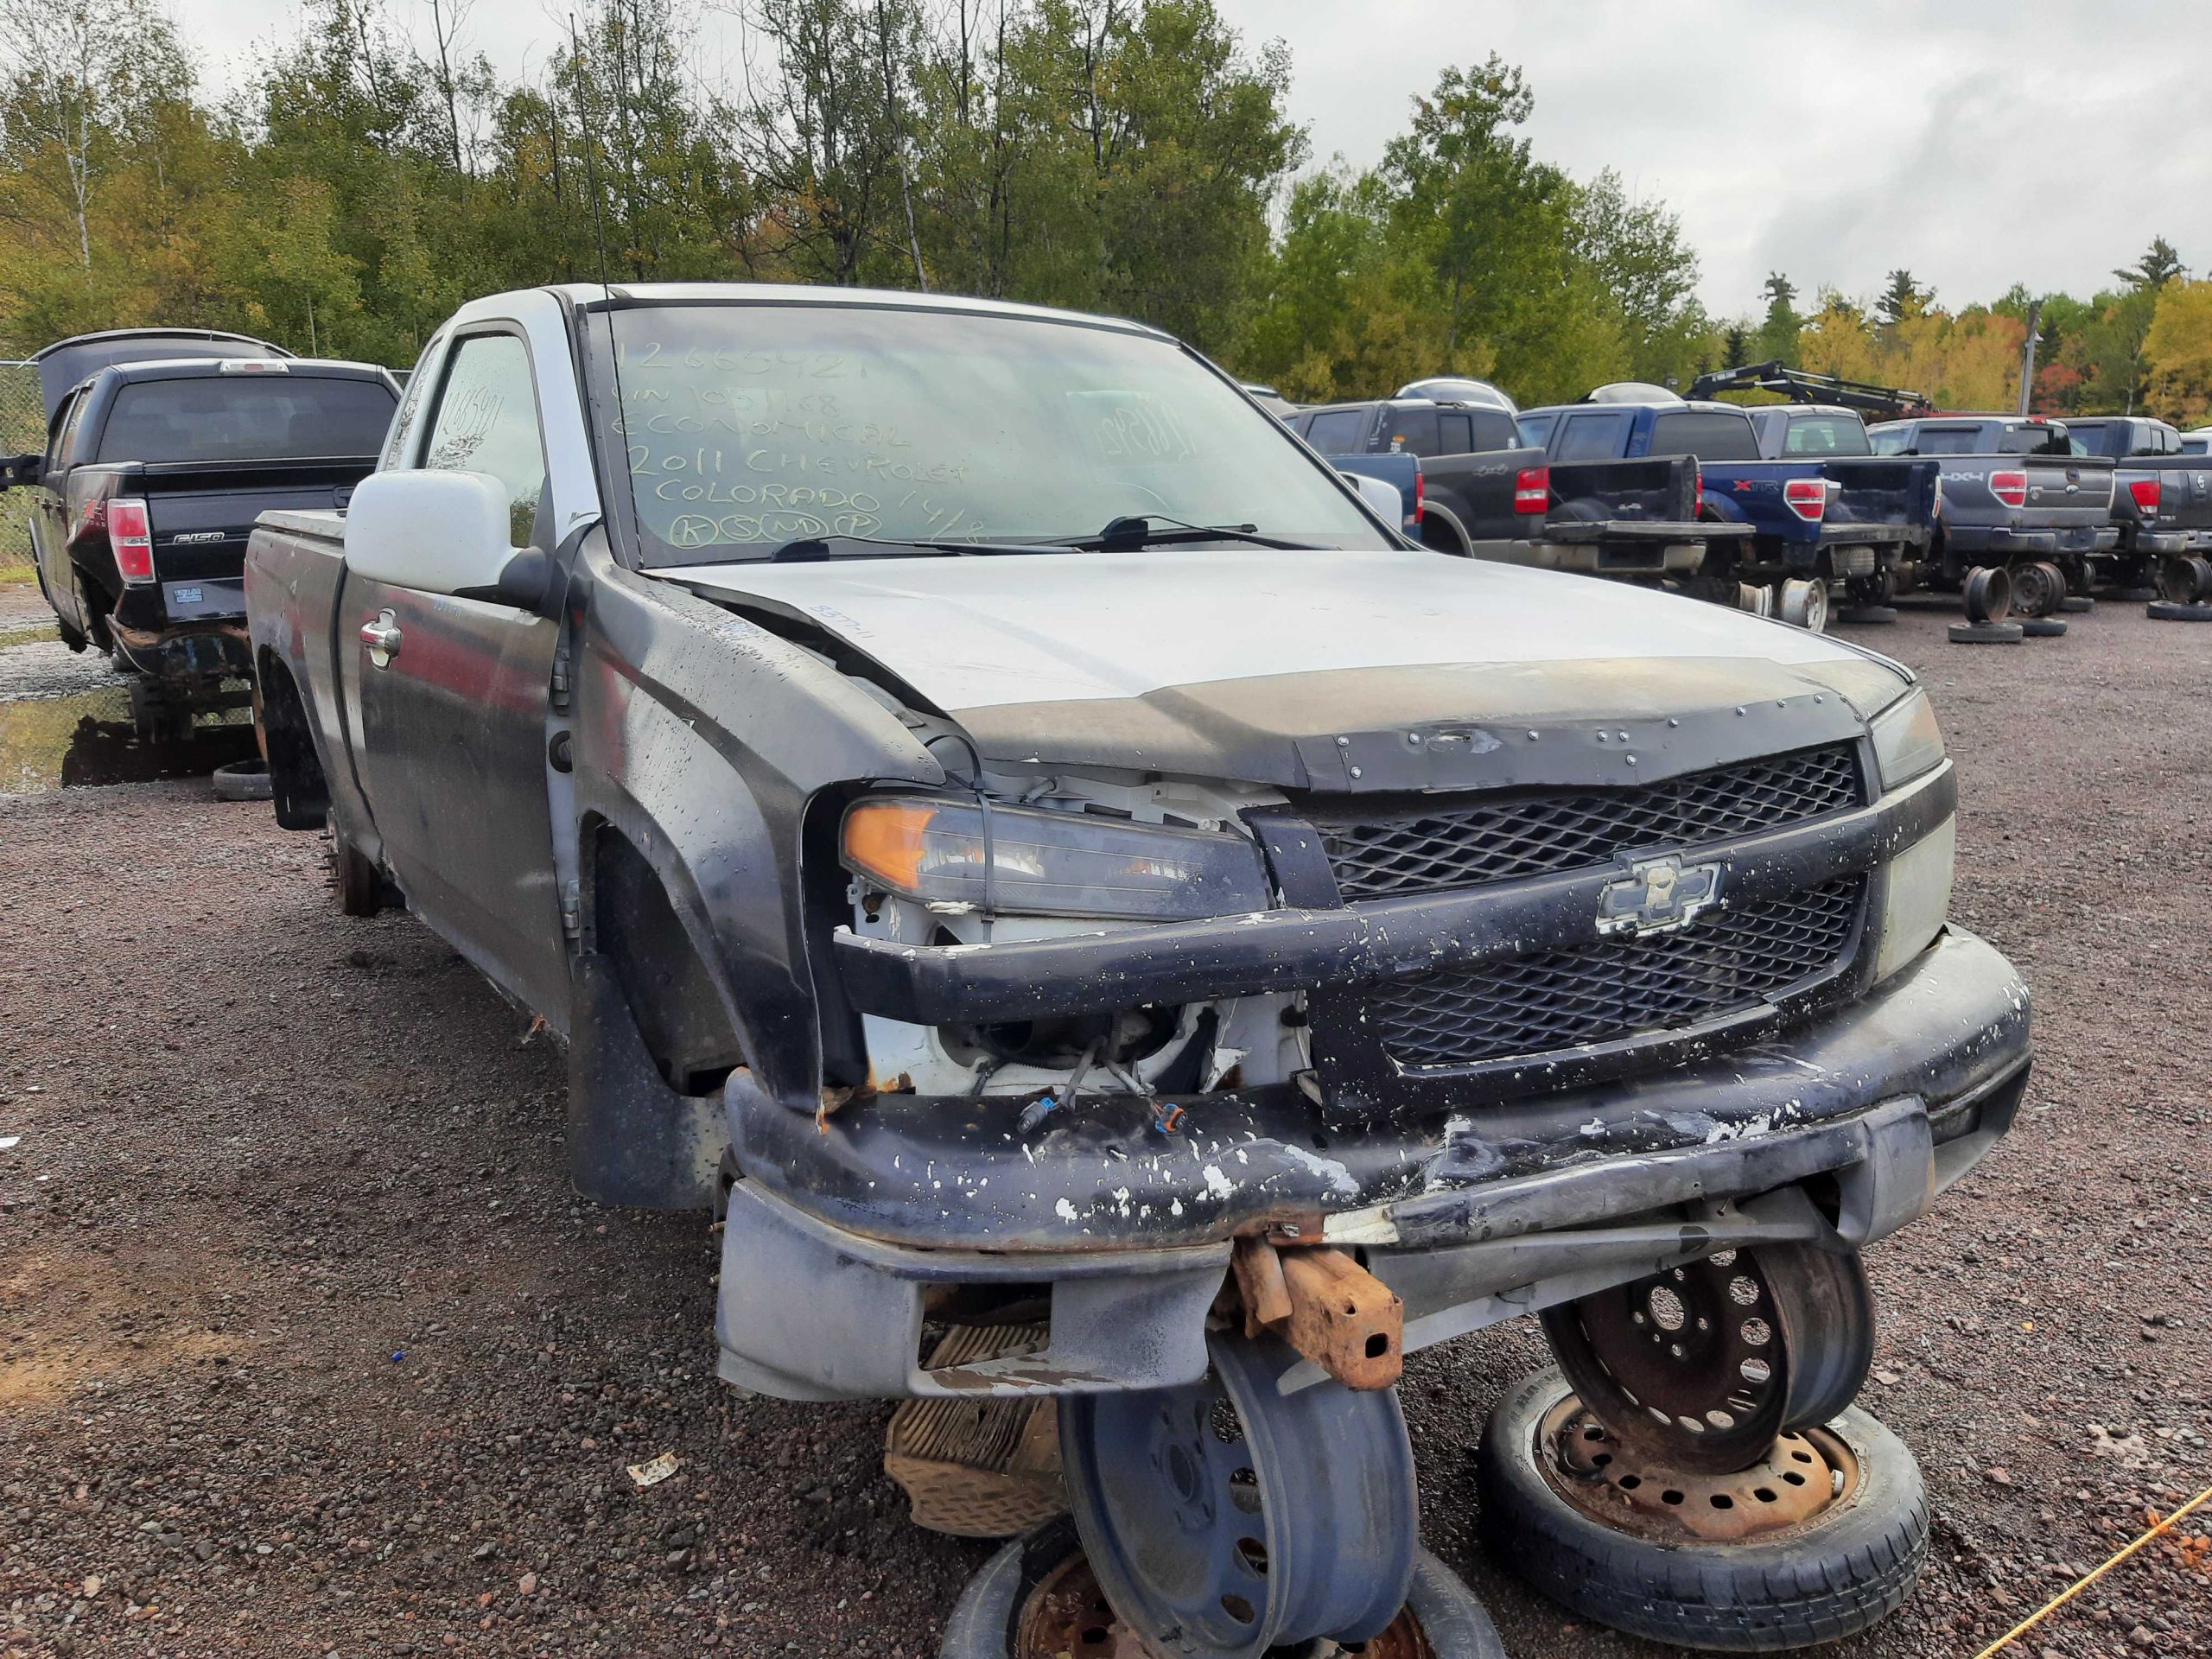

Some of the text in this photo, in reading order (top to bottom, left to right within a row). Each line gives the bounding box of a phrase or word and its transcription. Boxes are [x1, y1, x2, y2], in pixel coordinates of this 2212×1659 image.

[619, 342, 867, 378] 12665421
[611, 413, 911, 447] ECONOMICAL
[630, 445, 966, 482] 2011 CHEVROLET
[657, 479, 880, 512] COLORADO
